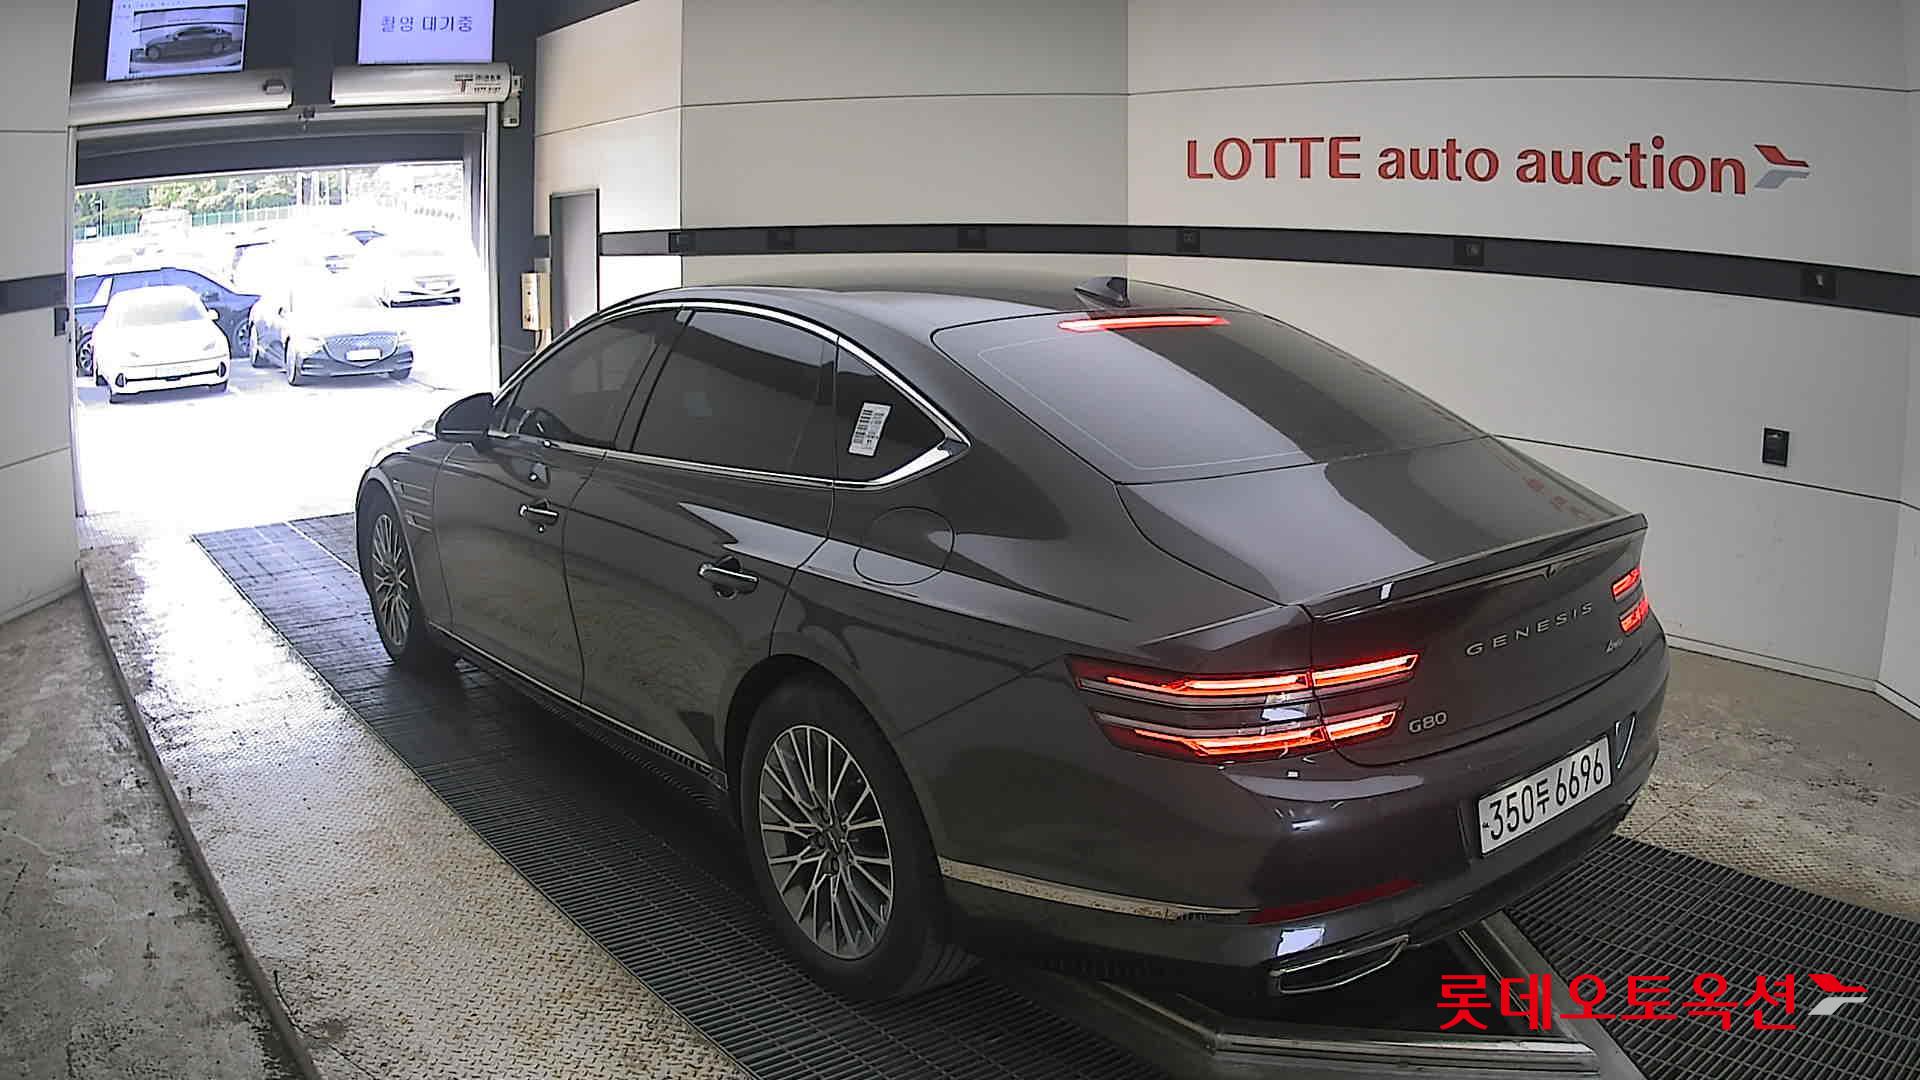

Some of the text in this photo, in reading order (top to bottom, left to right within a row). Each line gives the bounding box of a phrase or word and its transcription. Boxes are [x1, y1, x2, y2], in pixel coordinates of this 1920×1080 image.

[422, 15, 473, 32] 대기중
[1187, 135, 1746, 195] LOTTE auto auction
[1466, 602, 1593, 657] GENESIS
[1408, 711, 1448, 733] G80
